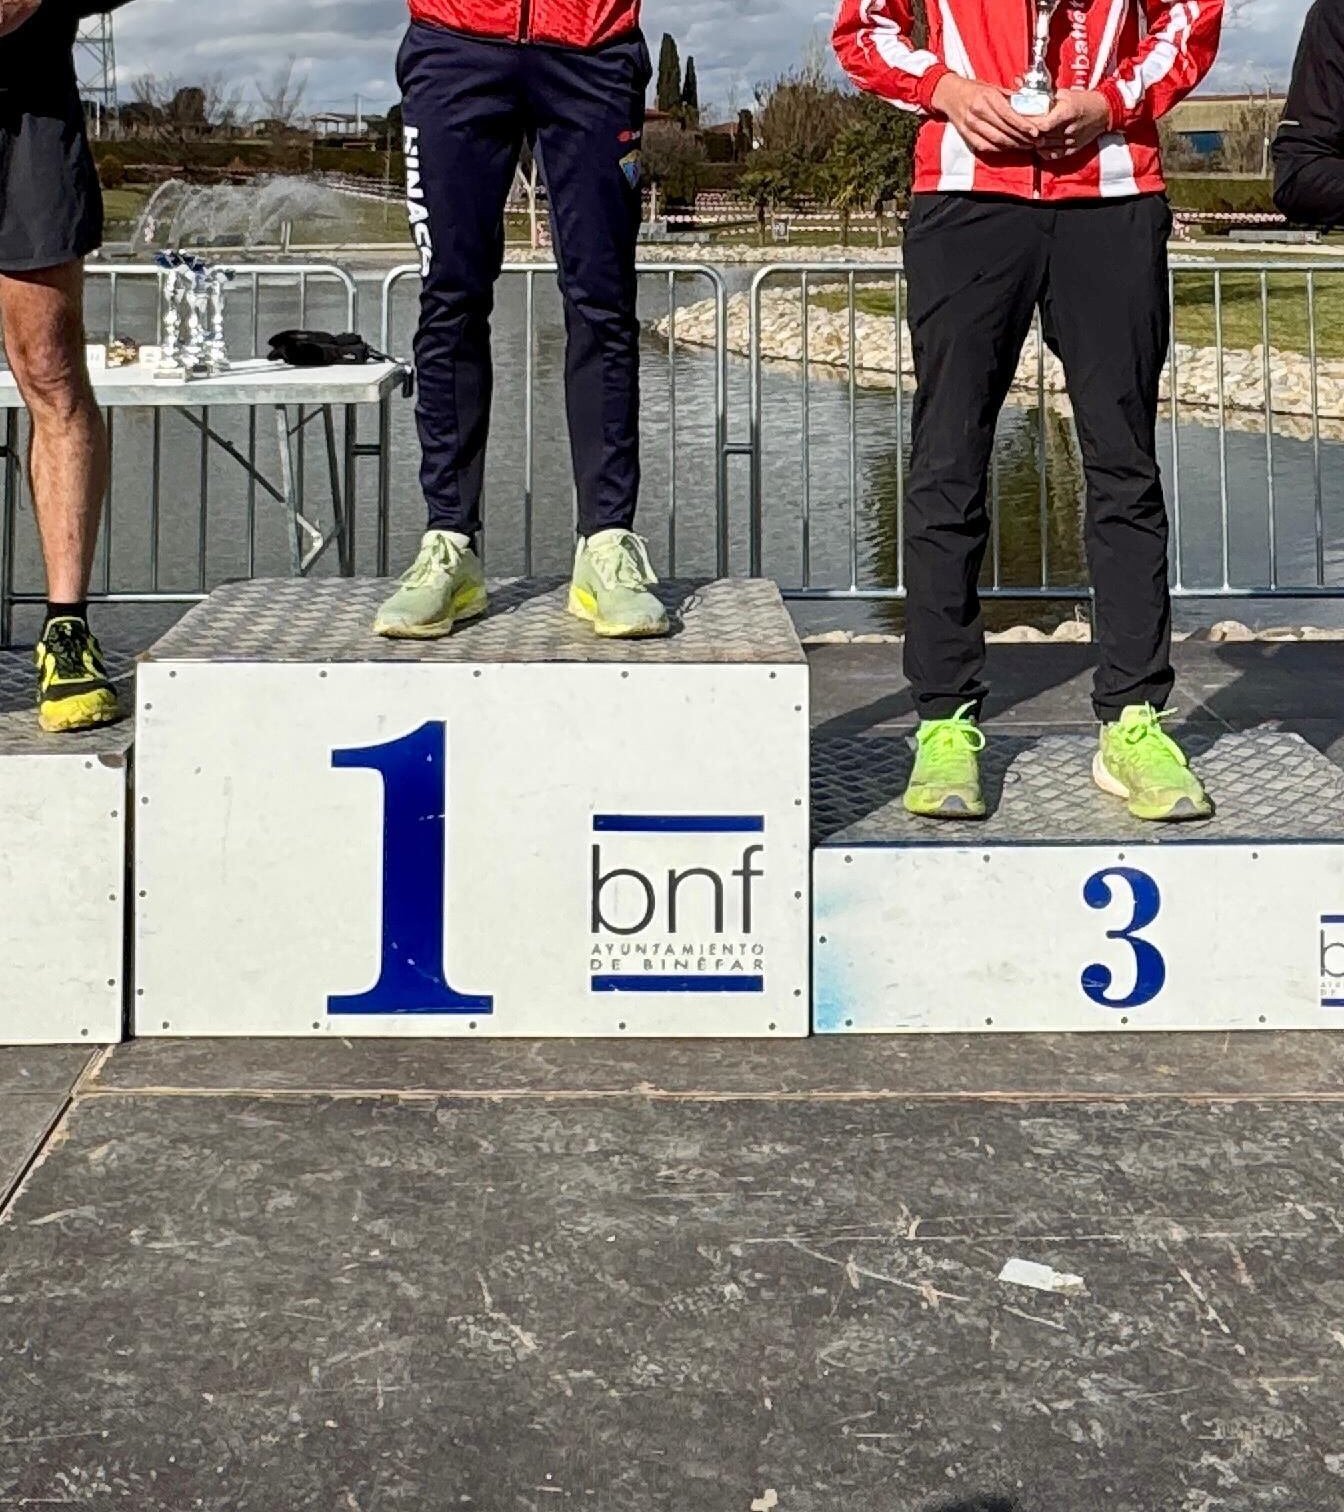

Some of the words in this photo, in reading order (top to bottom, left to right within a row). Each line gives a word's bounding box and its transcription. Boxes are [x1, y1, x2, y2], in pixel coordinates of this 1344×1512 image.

[327, 719, 494, 1015] 1
[590, 844, 764, 935] bnf
[590, 959, 621, 970] DE
[591, 943, 764, 955] AYUNTAMIENTO
[1080, 866, 1166, 1009] 3
